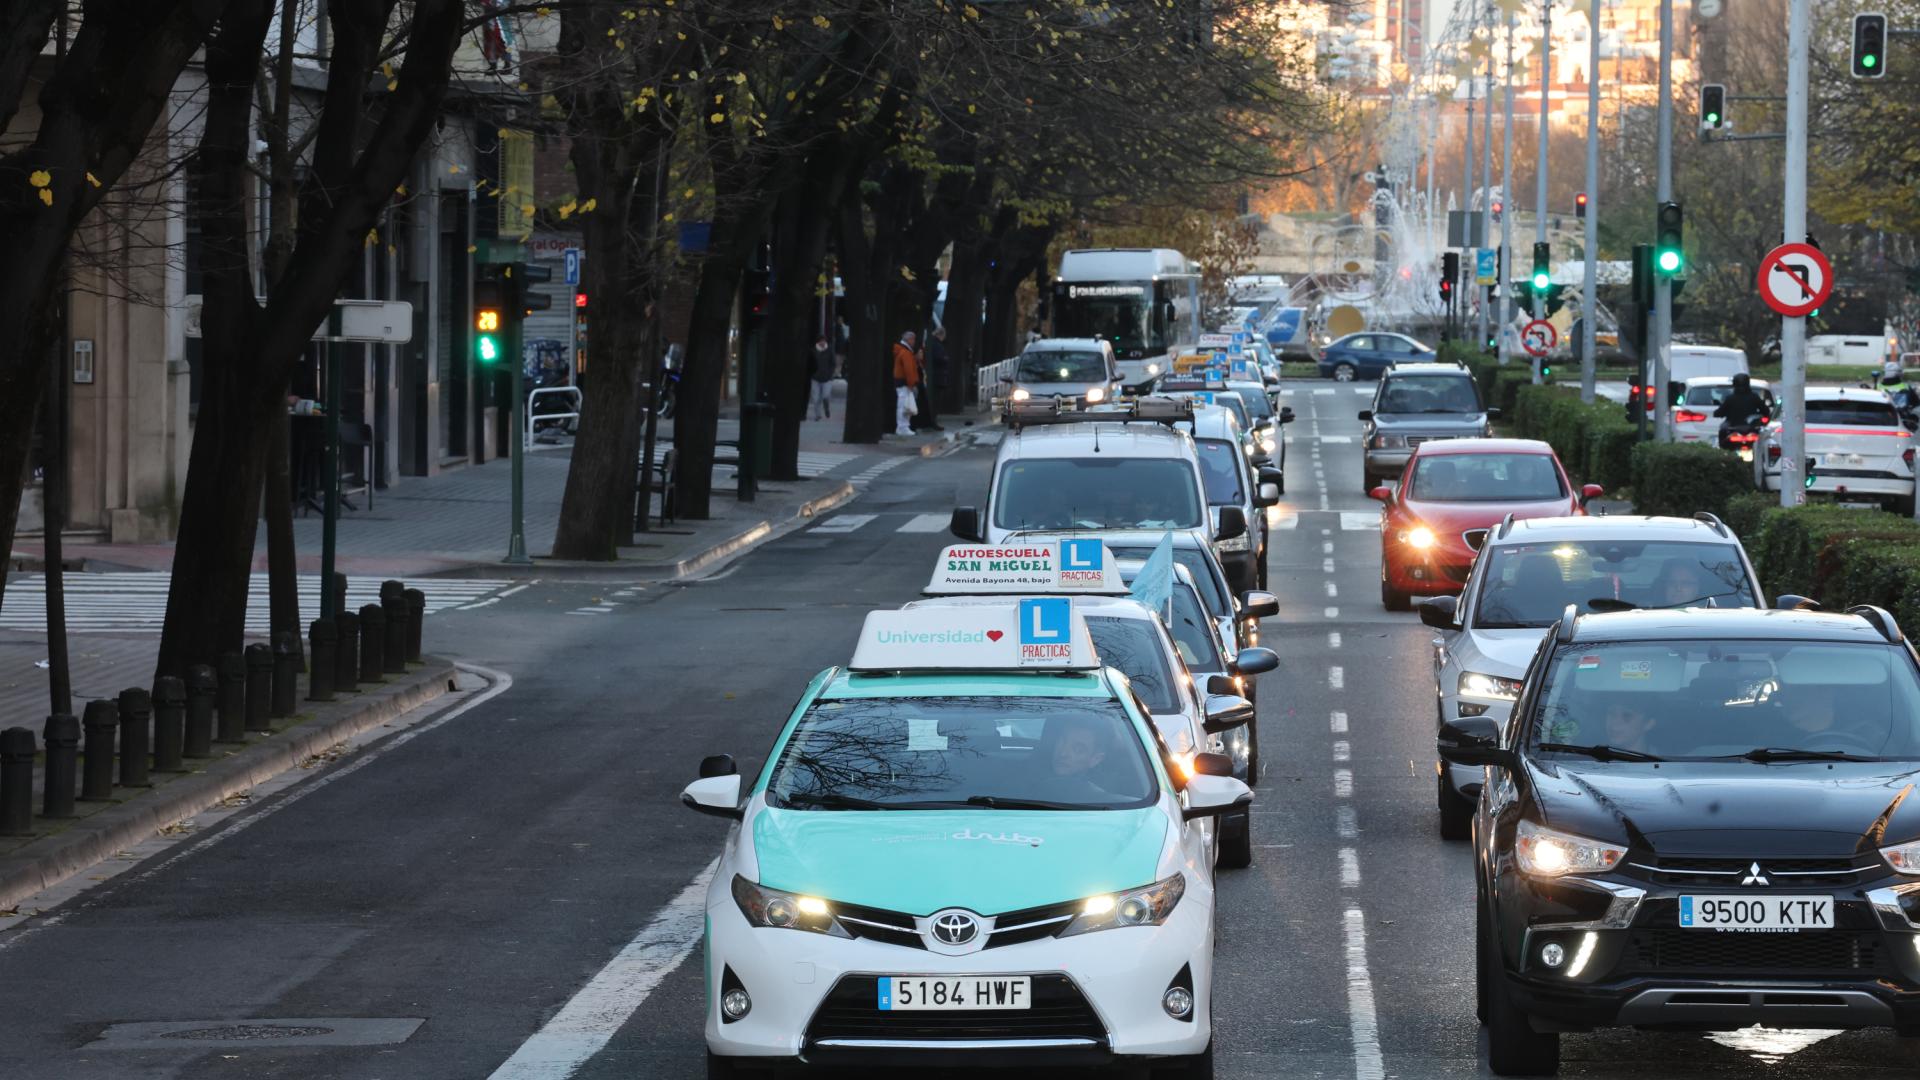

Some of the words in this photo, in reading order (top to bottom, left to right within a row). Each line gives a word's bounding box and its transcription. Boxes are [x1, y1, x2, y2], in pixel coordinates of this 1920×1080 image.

[566, 253, 576, 282] P
[948, 548, 1051, 558] AUTOESCUELA
[1070, 543, 1092, 566] L
[947, 560, 982, 571] SAN
[983, 577, 1015, 586] Bayona
[1031, 577, 1051, 586] bajo
[1061, 571, 1101, 581] PRACTICAS
[1032, 605, 1058, 638] L
[877, 629, 984, 643] Universidad
[1022, 644, 1070, 658] PRACTICAS
[1683, 914, 1690, 922] E
[1701, 900, 1766, 924] 9500
[1779, 901, 1827, 925] KTK
[882, 996, 889, 1004] E
[899, 981, 965, 1005] 5184
[975, 981, 1025, 1005] HWF
